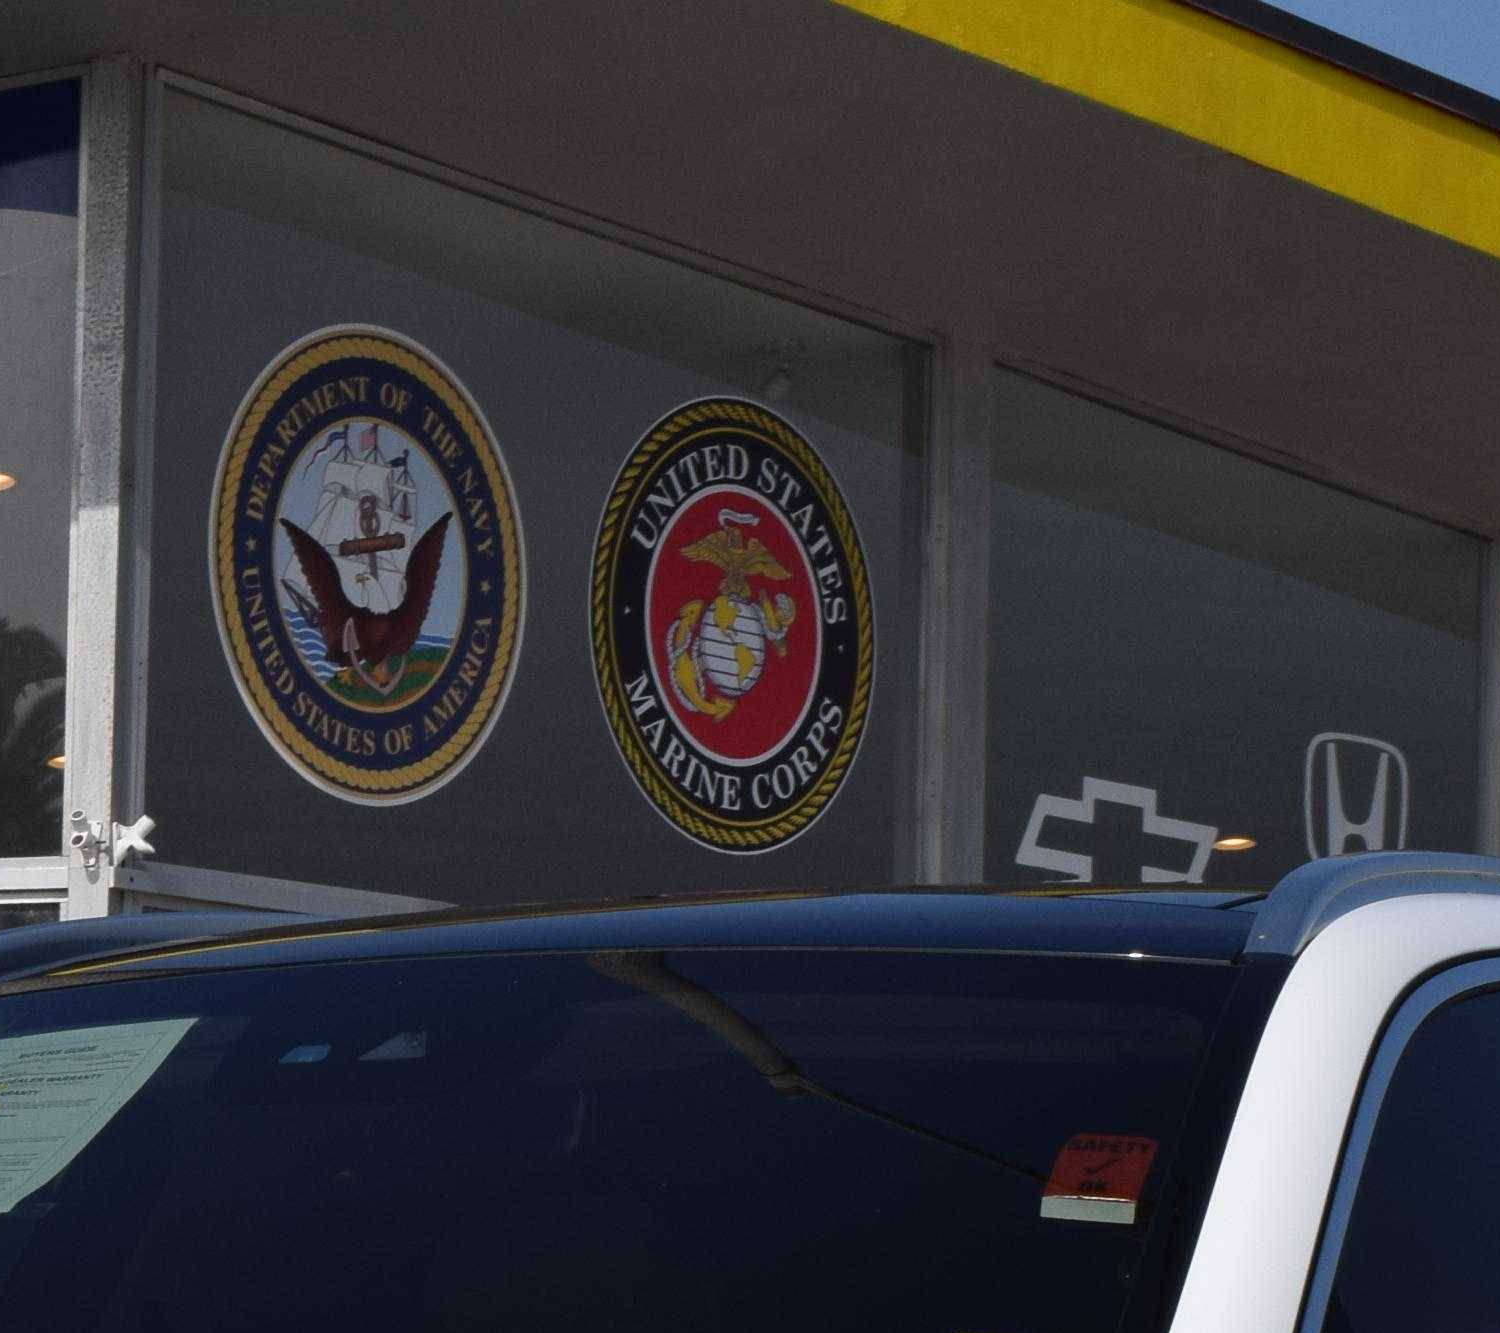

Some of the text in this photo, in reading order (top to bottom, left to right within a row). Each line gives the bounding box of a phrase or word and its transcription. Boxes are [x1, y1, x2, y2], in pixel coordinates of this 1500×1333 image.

[244, 376, 495, 557] DEPARTMENT OF THE NAVY
[630, 444, 849, 626] UNITED STATES
[241, 566, 493, 756] UNITED STATES OF AMERICA
[624, 669, 844, 812] MARINE CORPS
